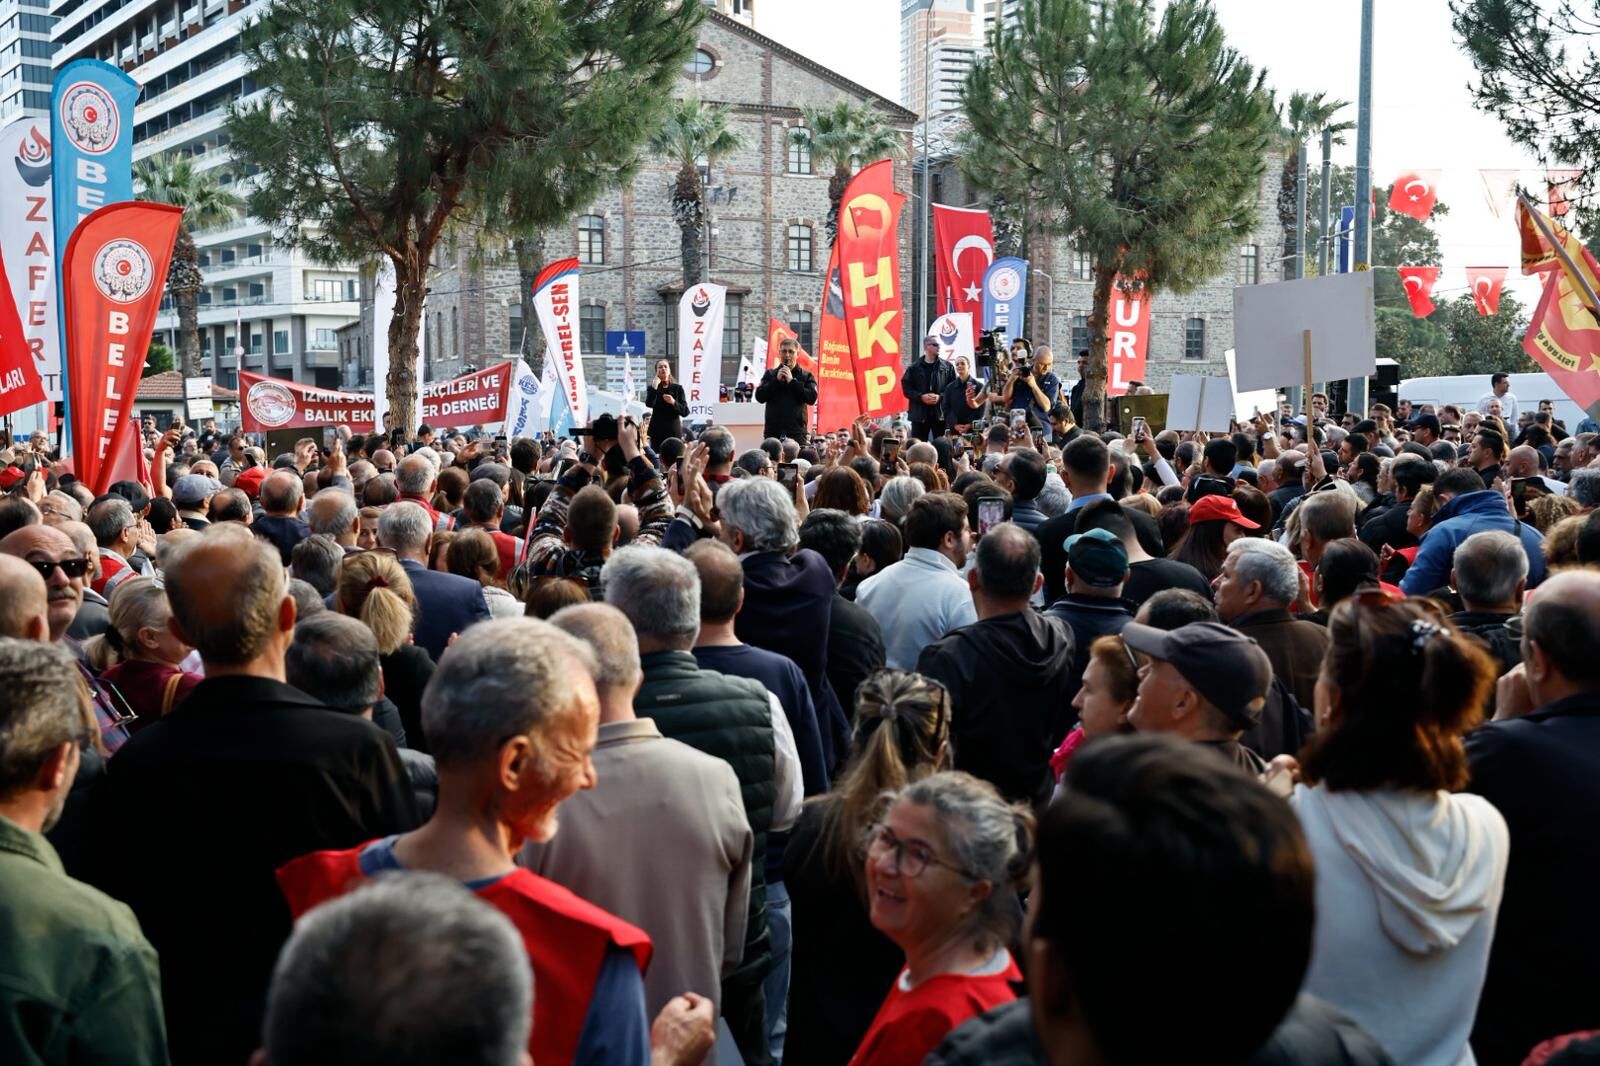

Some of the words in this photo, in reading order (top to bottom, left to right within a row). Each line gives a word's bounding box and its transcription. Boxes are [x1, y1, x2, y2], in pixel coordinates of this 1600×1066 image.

[76, 157, 108, 225] BE
[25, 196, 50, 361] ZAFER
[848, 256, 899, 411] HKP
[995, 303, 1009, 347] BE
[482, 374, 500, 389] VE
[691, 321, 704, 401] ZAFER
[304, 408, 348, 422] BALIK
[442, 393, 500, 415] DERNEĞİ
